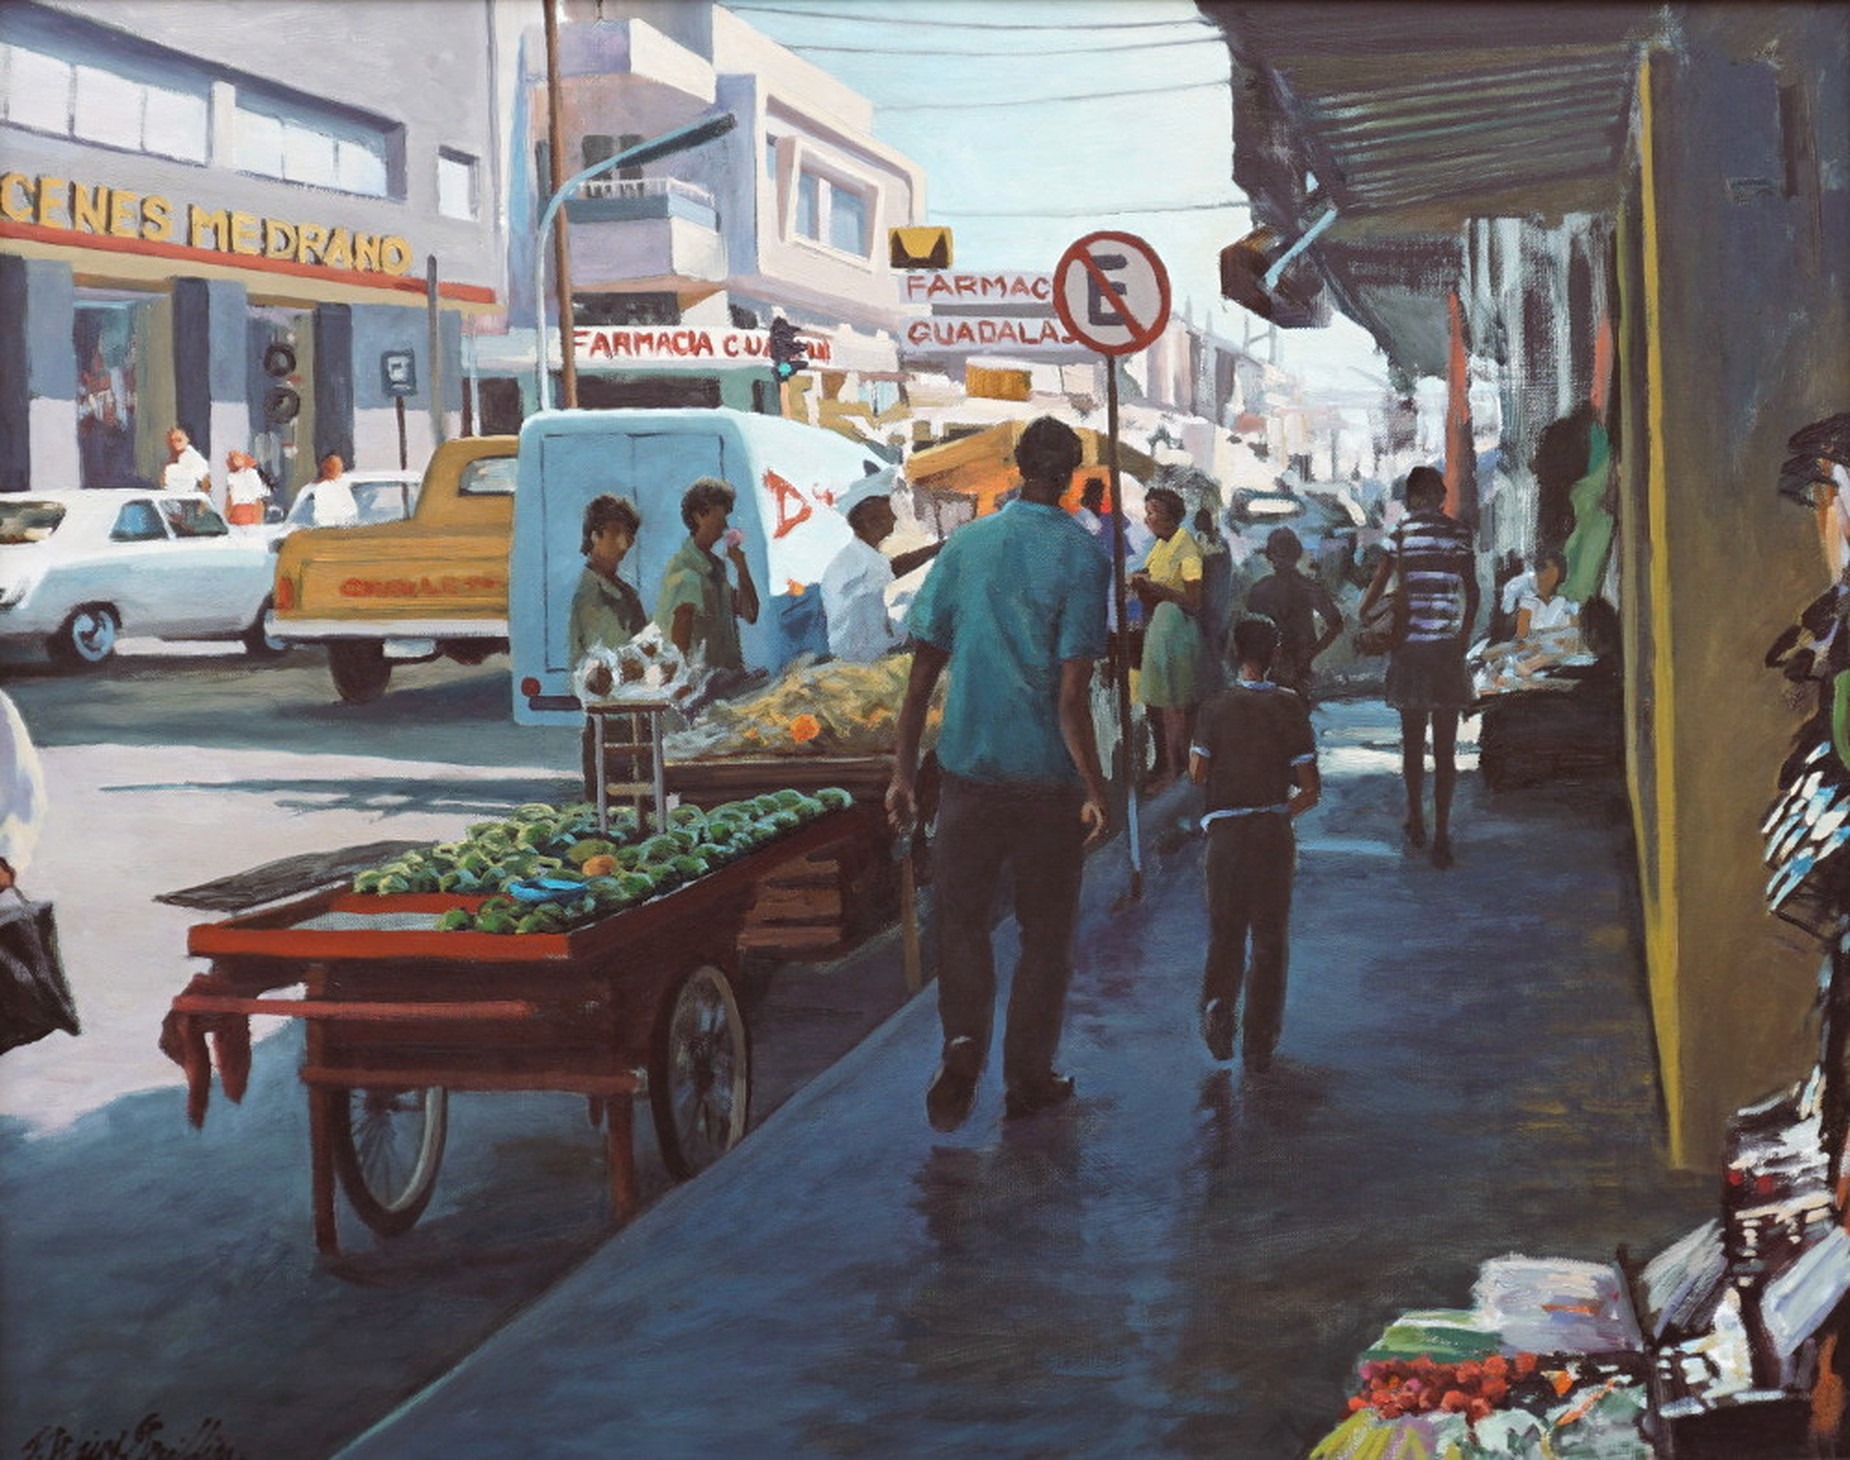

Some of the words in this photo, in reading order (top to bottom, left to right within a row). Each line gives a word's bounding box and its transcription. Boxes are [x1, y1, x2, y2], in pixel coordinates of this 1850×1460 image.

[0, 171, 173, 241] CENES
[187, 203, 413, 276] MEDRANO
[907, 274, 1051, 301] FARMAC
[1088, 254, 1128, 326] E
[573, 330, 714, 358] FARMACIA
